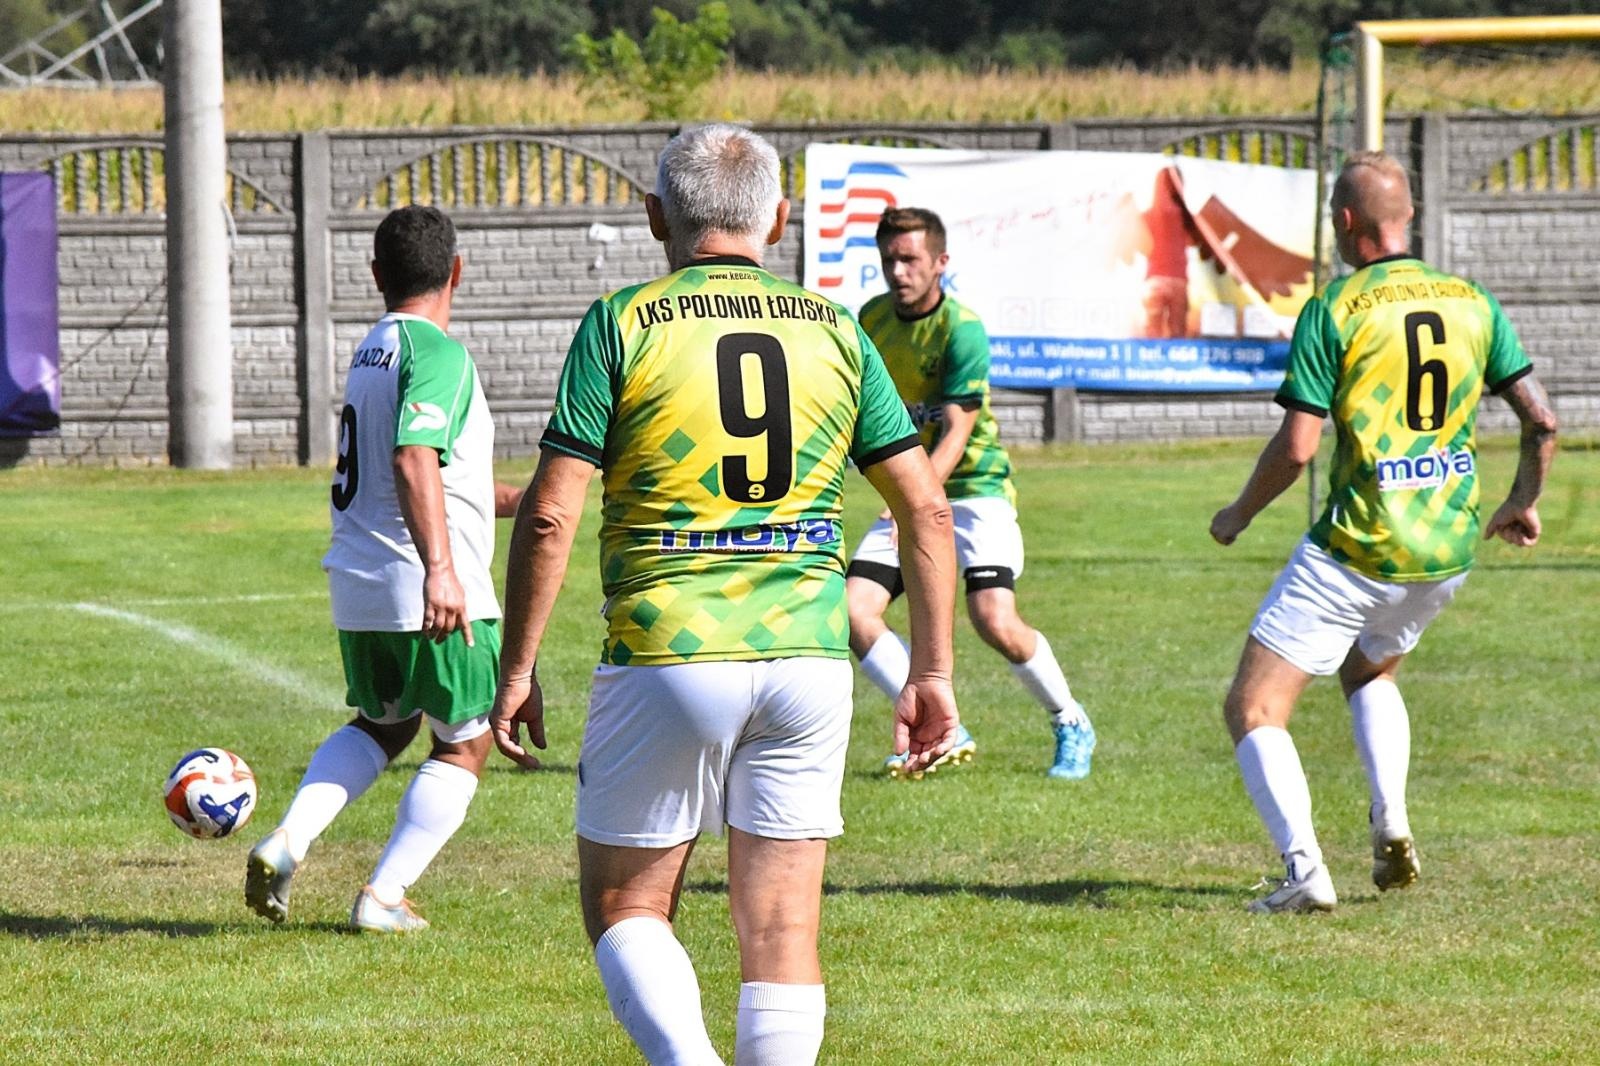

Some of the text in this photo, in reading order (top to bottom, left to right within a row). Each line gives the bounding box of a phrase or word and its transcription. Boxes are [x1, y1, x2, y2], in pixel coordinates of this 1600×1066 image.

[636, 294, 838, 329] LKS POLONIA ŁAZISKA
[1345, 292, 1373, 315] LKS
[1372, 283, 1429, 304] POLONIA
[716, 332, 793, 503] 9
[1405, 311, 1449, 431] 6
[332, 404, 360, 512] 9
